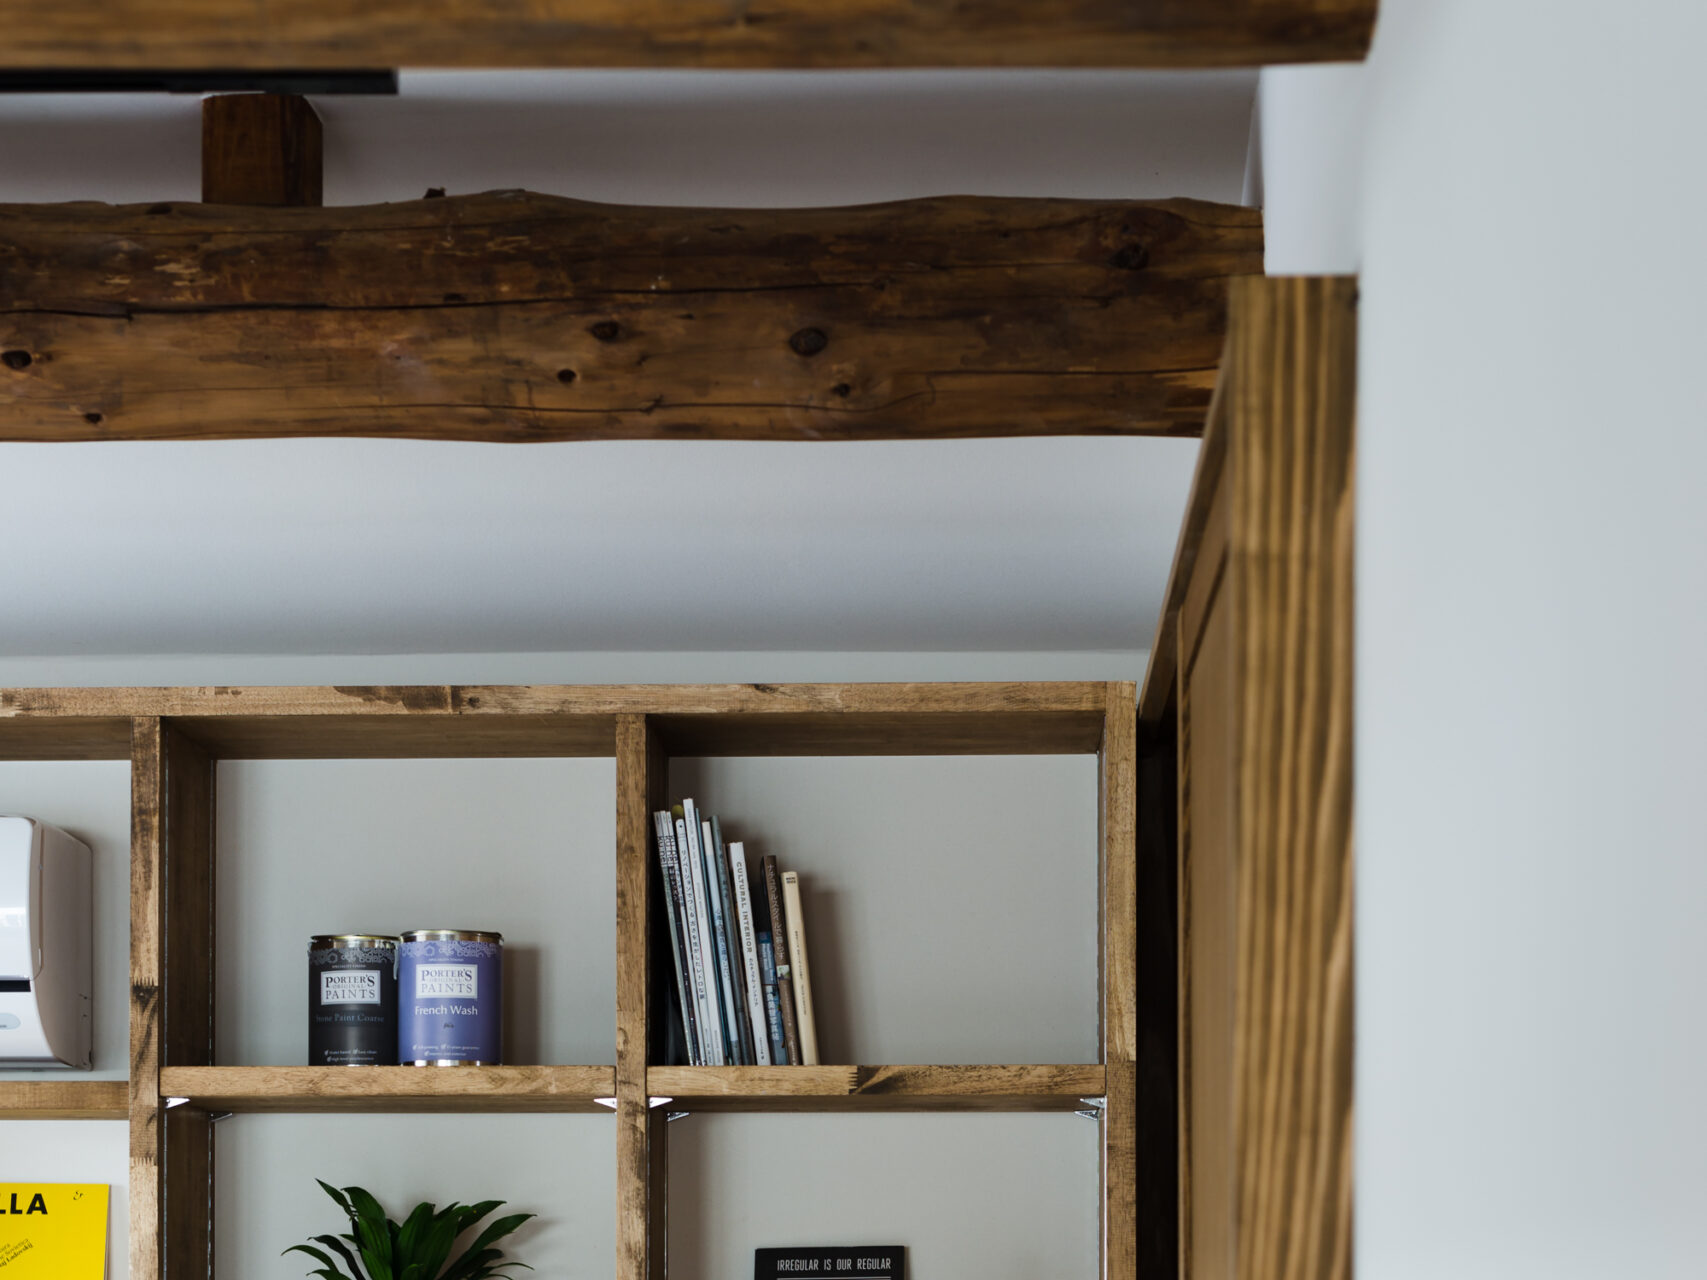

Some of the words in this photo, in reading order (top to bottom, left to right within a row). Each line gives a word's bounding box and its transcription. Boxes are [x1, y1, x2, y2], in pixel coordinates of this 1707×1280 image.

[736, 861, 749, 907] CULTURAL
[742, 908, 754, 954] INTERIOR
[325, 973, 375, 988] PORTER'S
[421, 968, 473, 982] PORTER'S
[325, 988, 376, 1000] PAINTS
[421, 983, 473, 993] PAINTS
[415, 1004, 448, 1016] French
[449, 1004, 479, 1016] Wash
[777, 1259, 819, 1271] IRREGULAR
[824, 1259, 832, 1271] IS
[837, 1259, 852, 1270] OUR
[857, 1258, 891, 1270] REGULAR
